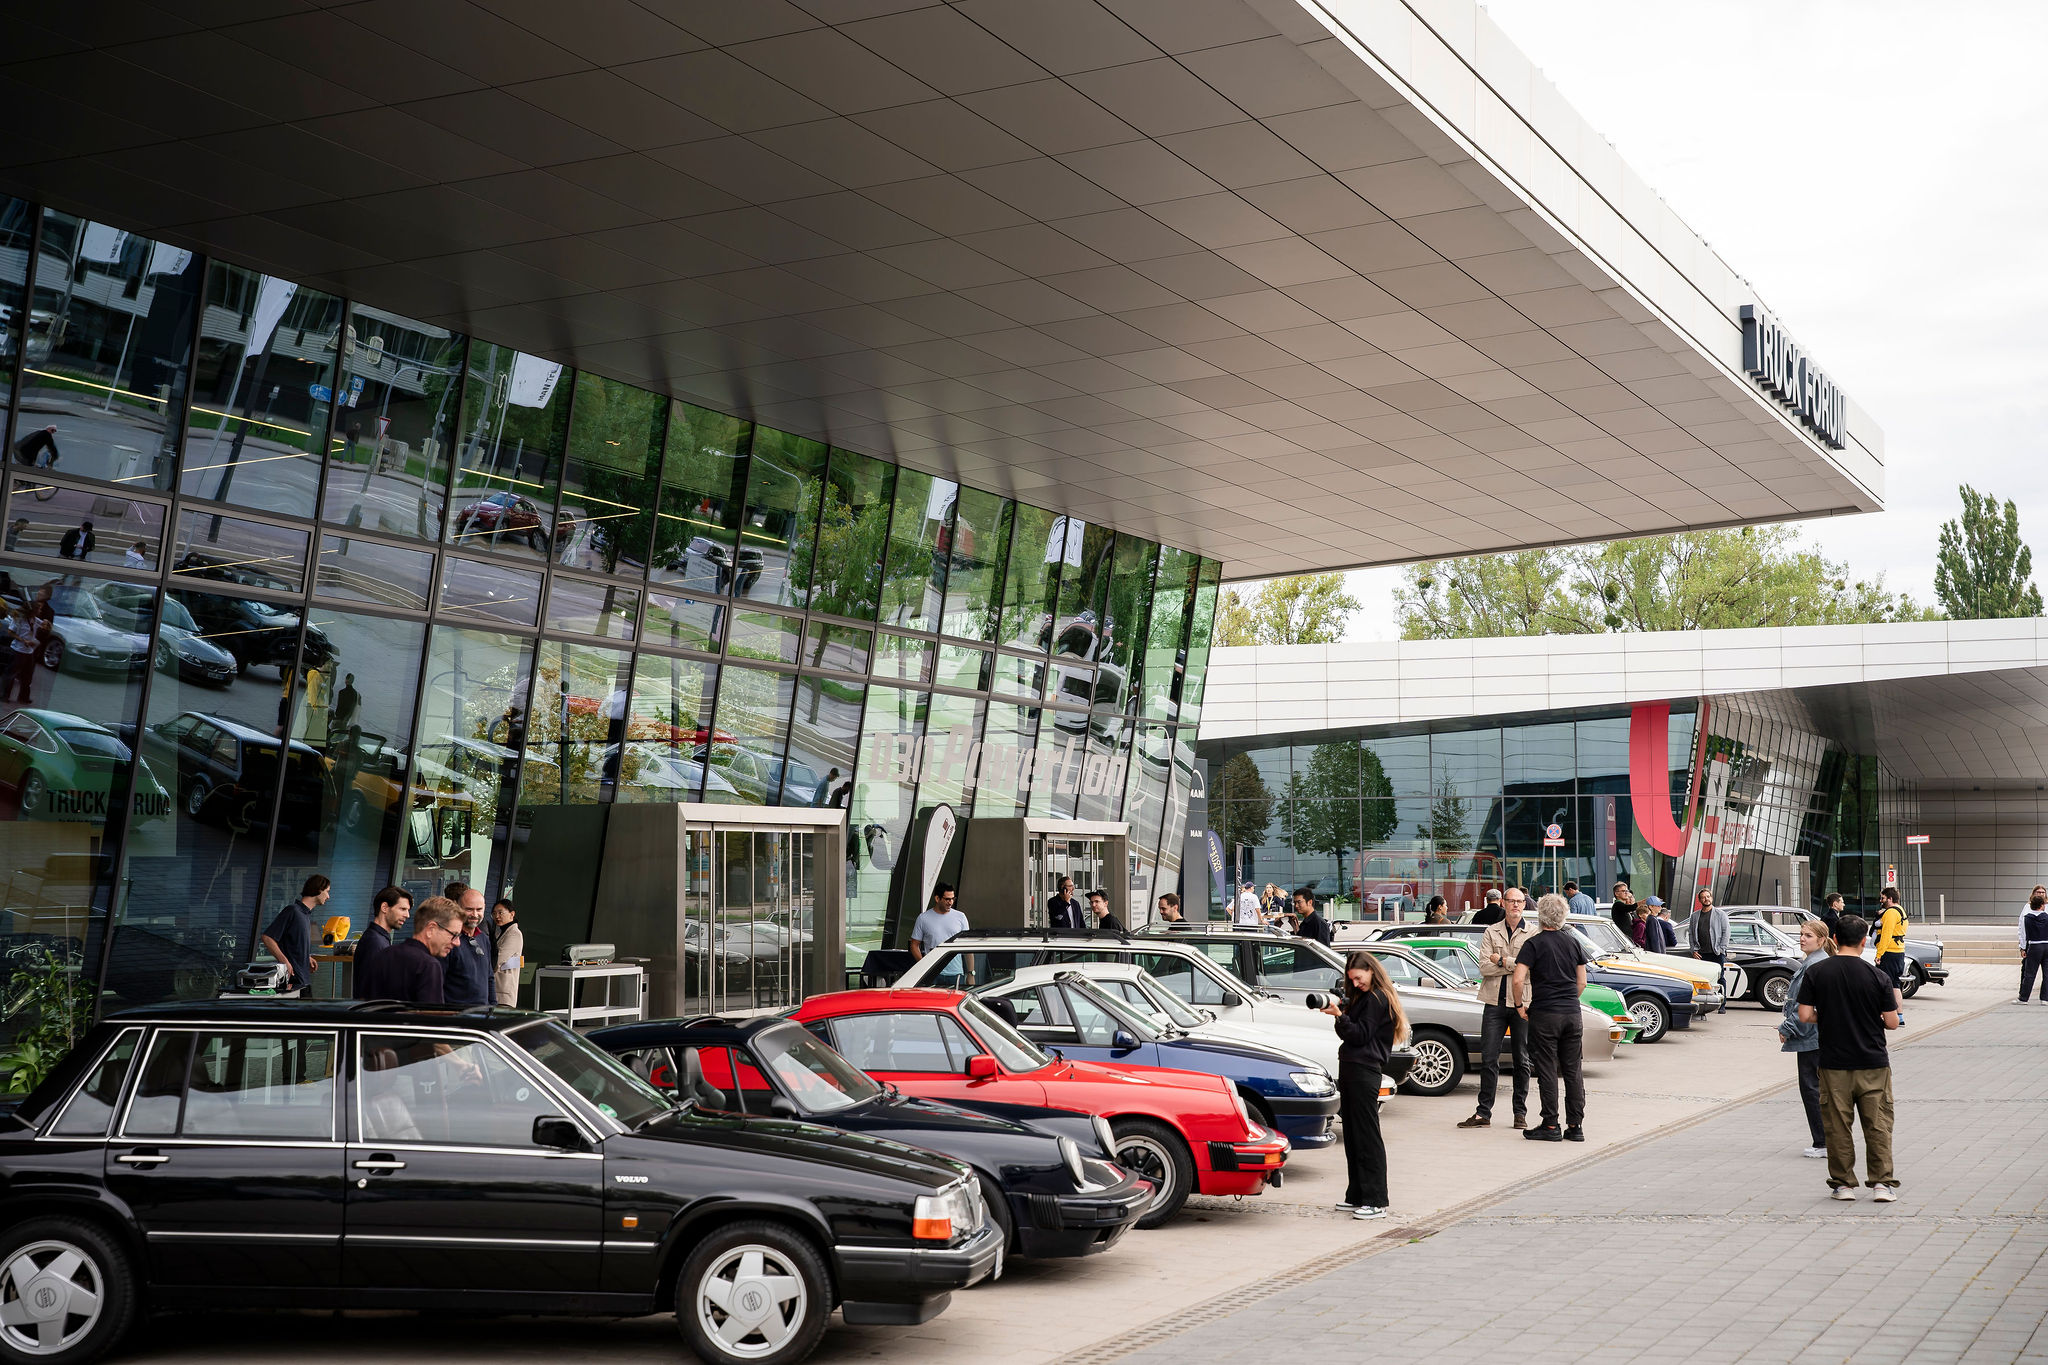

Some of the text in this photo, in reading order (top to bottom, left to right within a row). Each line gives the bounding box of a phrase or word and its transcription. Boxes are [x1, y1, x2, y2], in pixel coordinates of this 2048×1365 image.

[1739, 304, 1848, 450] TRUCK FORUM
[868, 724, 1128, 797] D30 PowerLion
[47, 789, 170, 816] TRUCK RUM
[1190, 829, 1203, 838] MAN
[615, 1175, 649, 1184] VOLVO
